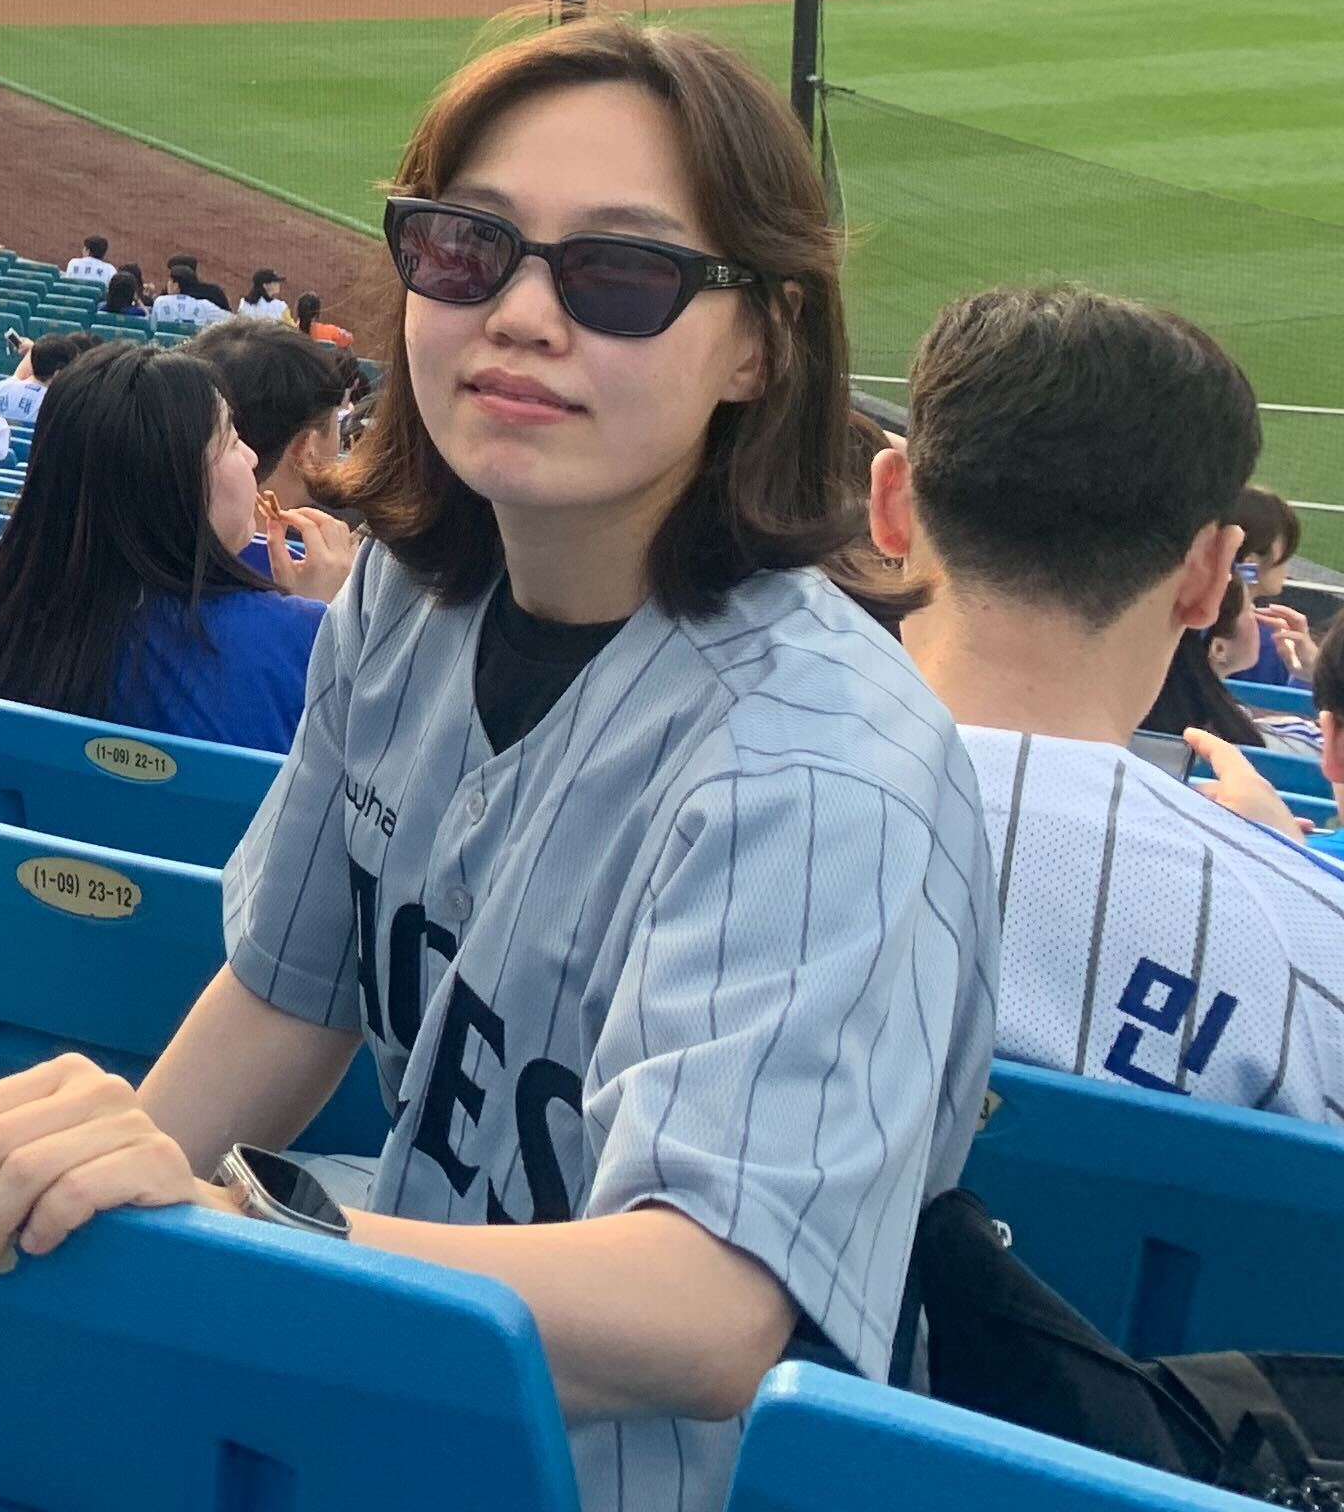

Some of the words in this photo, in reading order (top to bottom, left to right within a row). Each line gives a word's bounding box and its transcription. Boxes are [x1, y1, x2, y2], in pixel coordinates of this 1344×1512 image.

[96, 743, 130, 766] (1-09)
[135, 752, 166, 772] 22-11
[34, 866, 80, 898] (1-09)
[88, 879, 133, 907] 23-12
[1103, 955, 1239, 1096] 민
